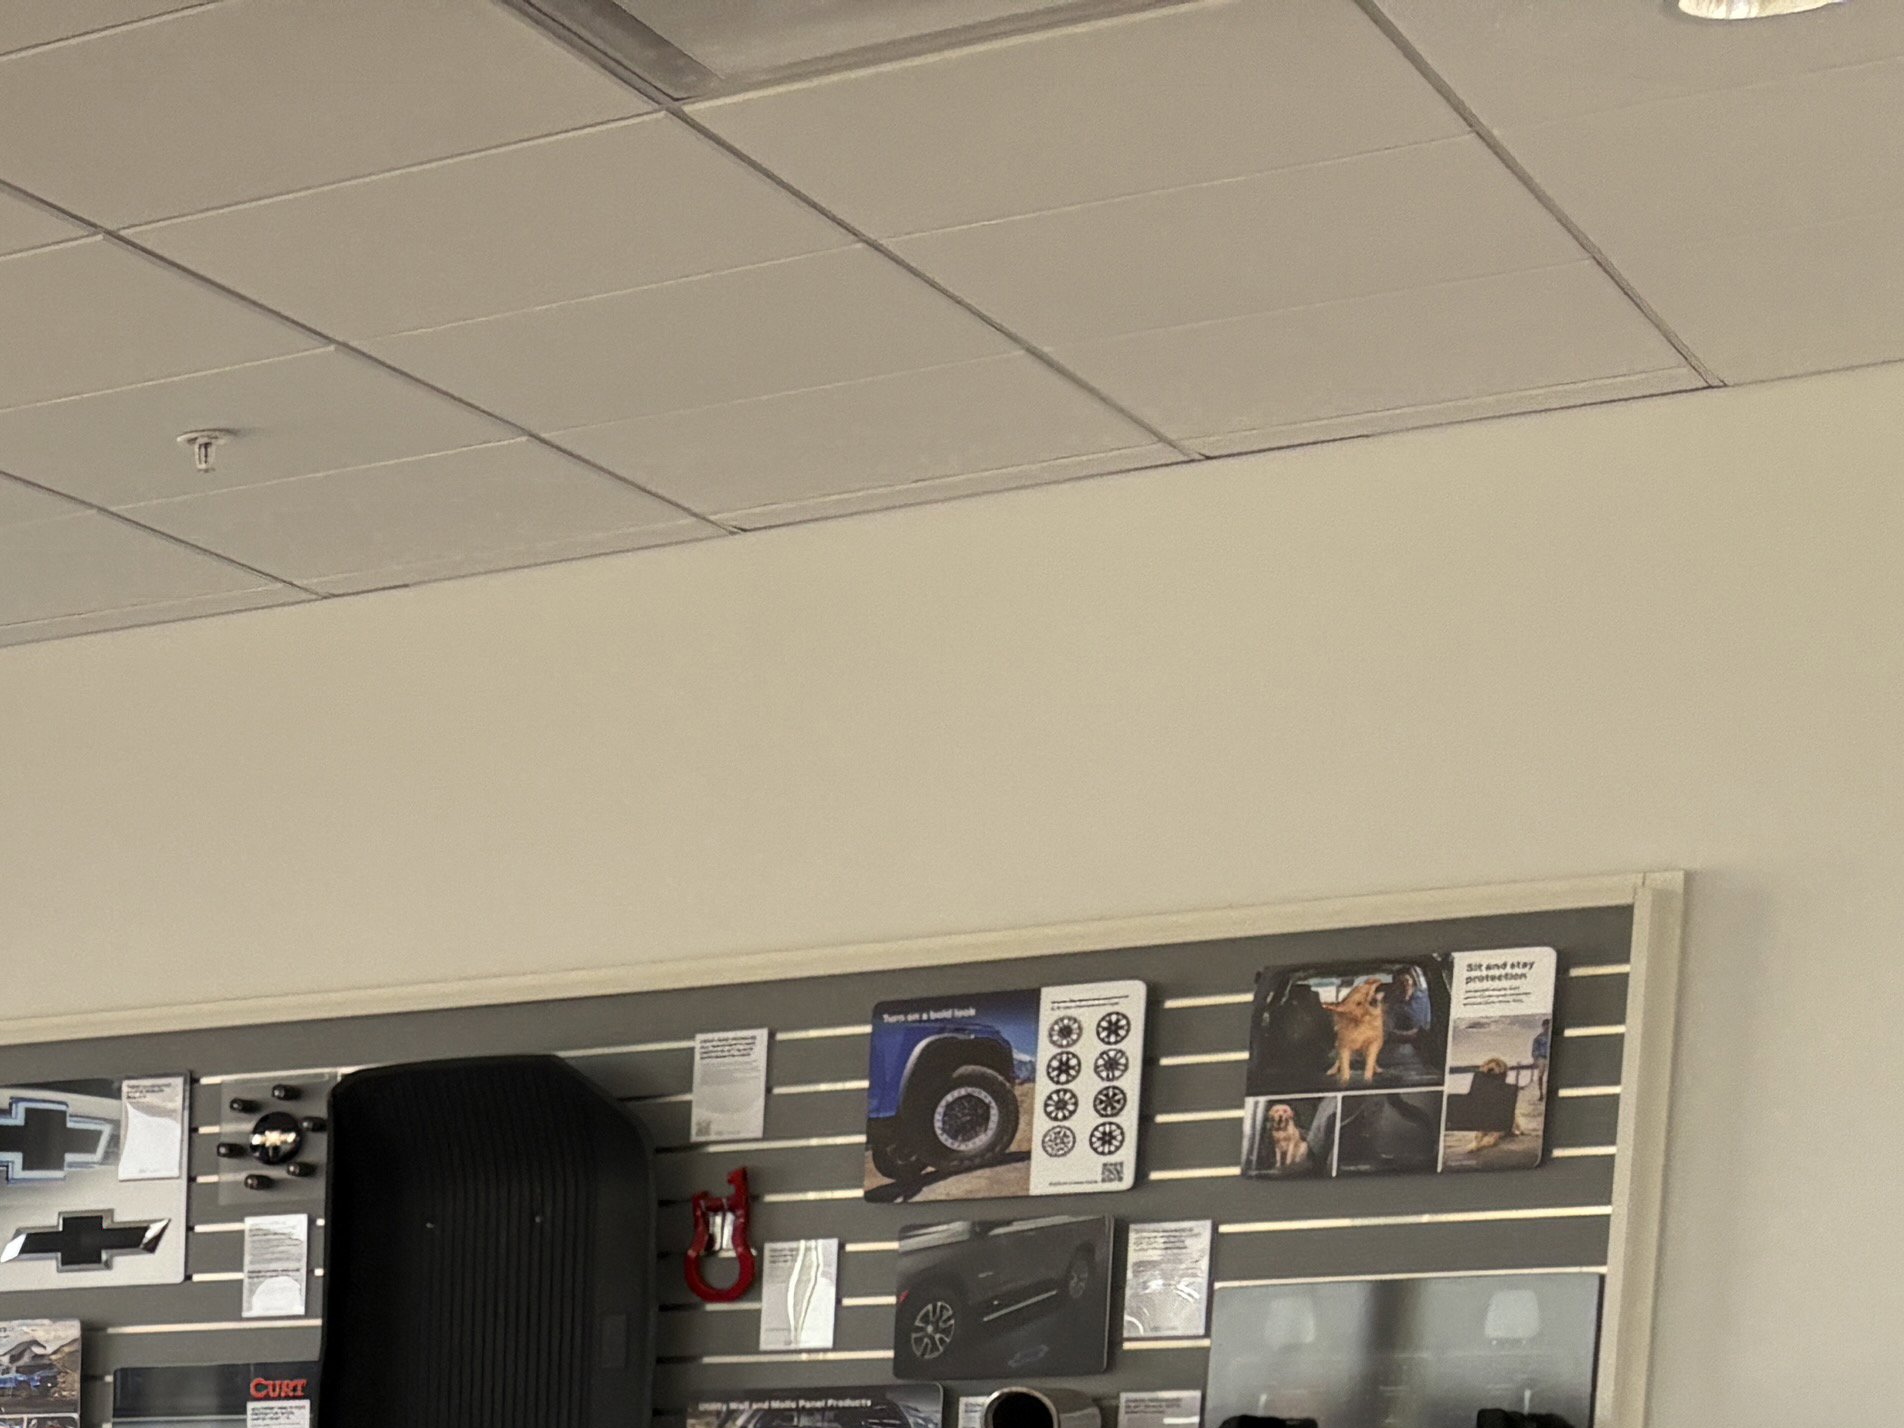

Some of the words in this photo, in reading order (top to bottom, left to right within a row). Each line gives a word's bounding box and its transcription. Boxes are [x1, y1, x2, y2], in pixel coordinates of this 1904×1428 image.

[1466, 963, 1484, 972] Sit
[1485, 962, 1507, 971] and
[1510, 961, 1535, 971] stay
[1465, 973, 1527, 984] protection
[250, 1377, 307, 1398] CURT
